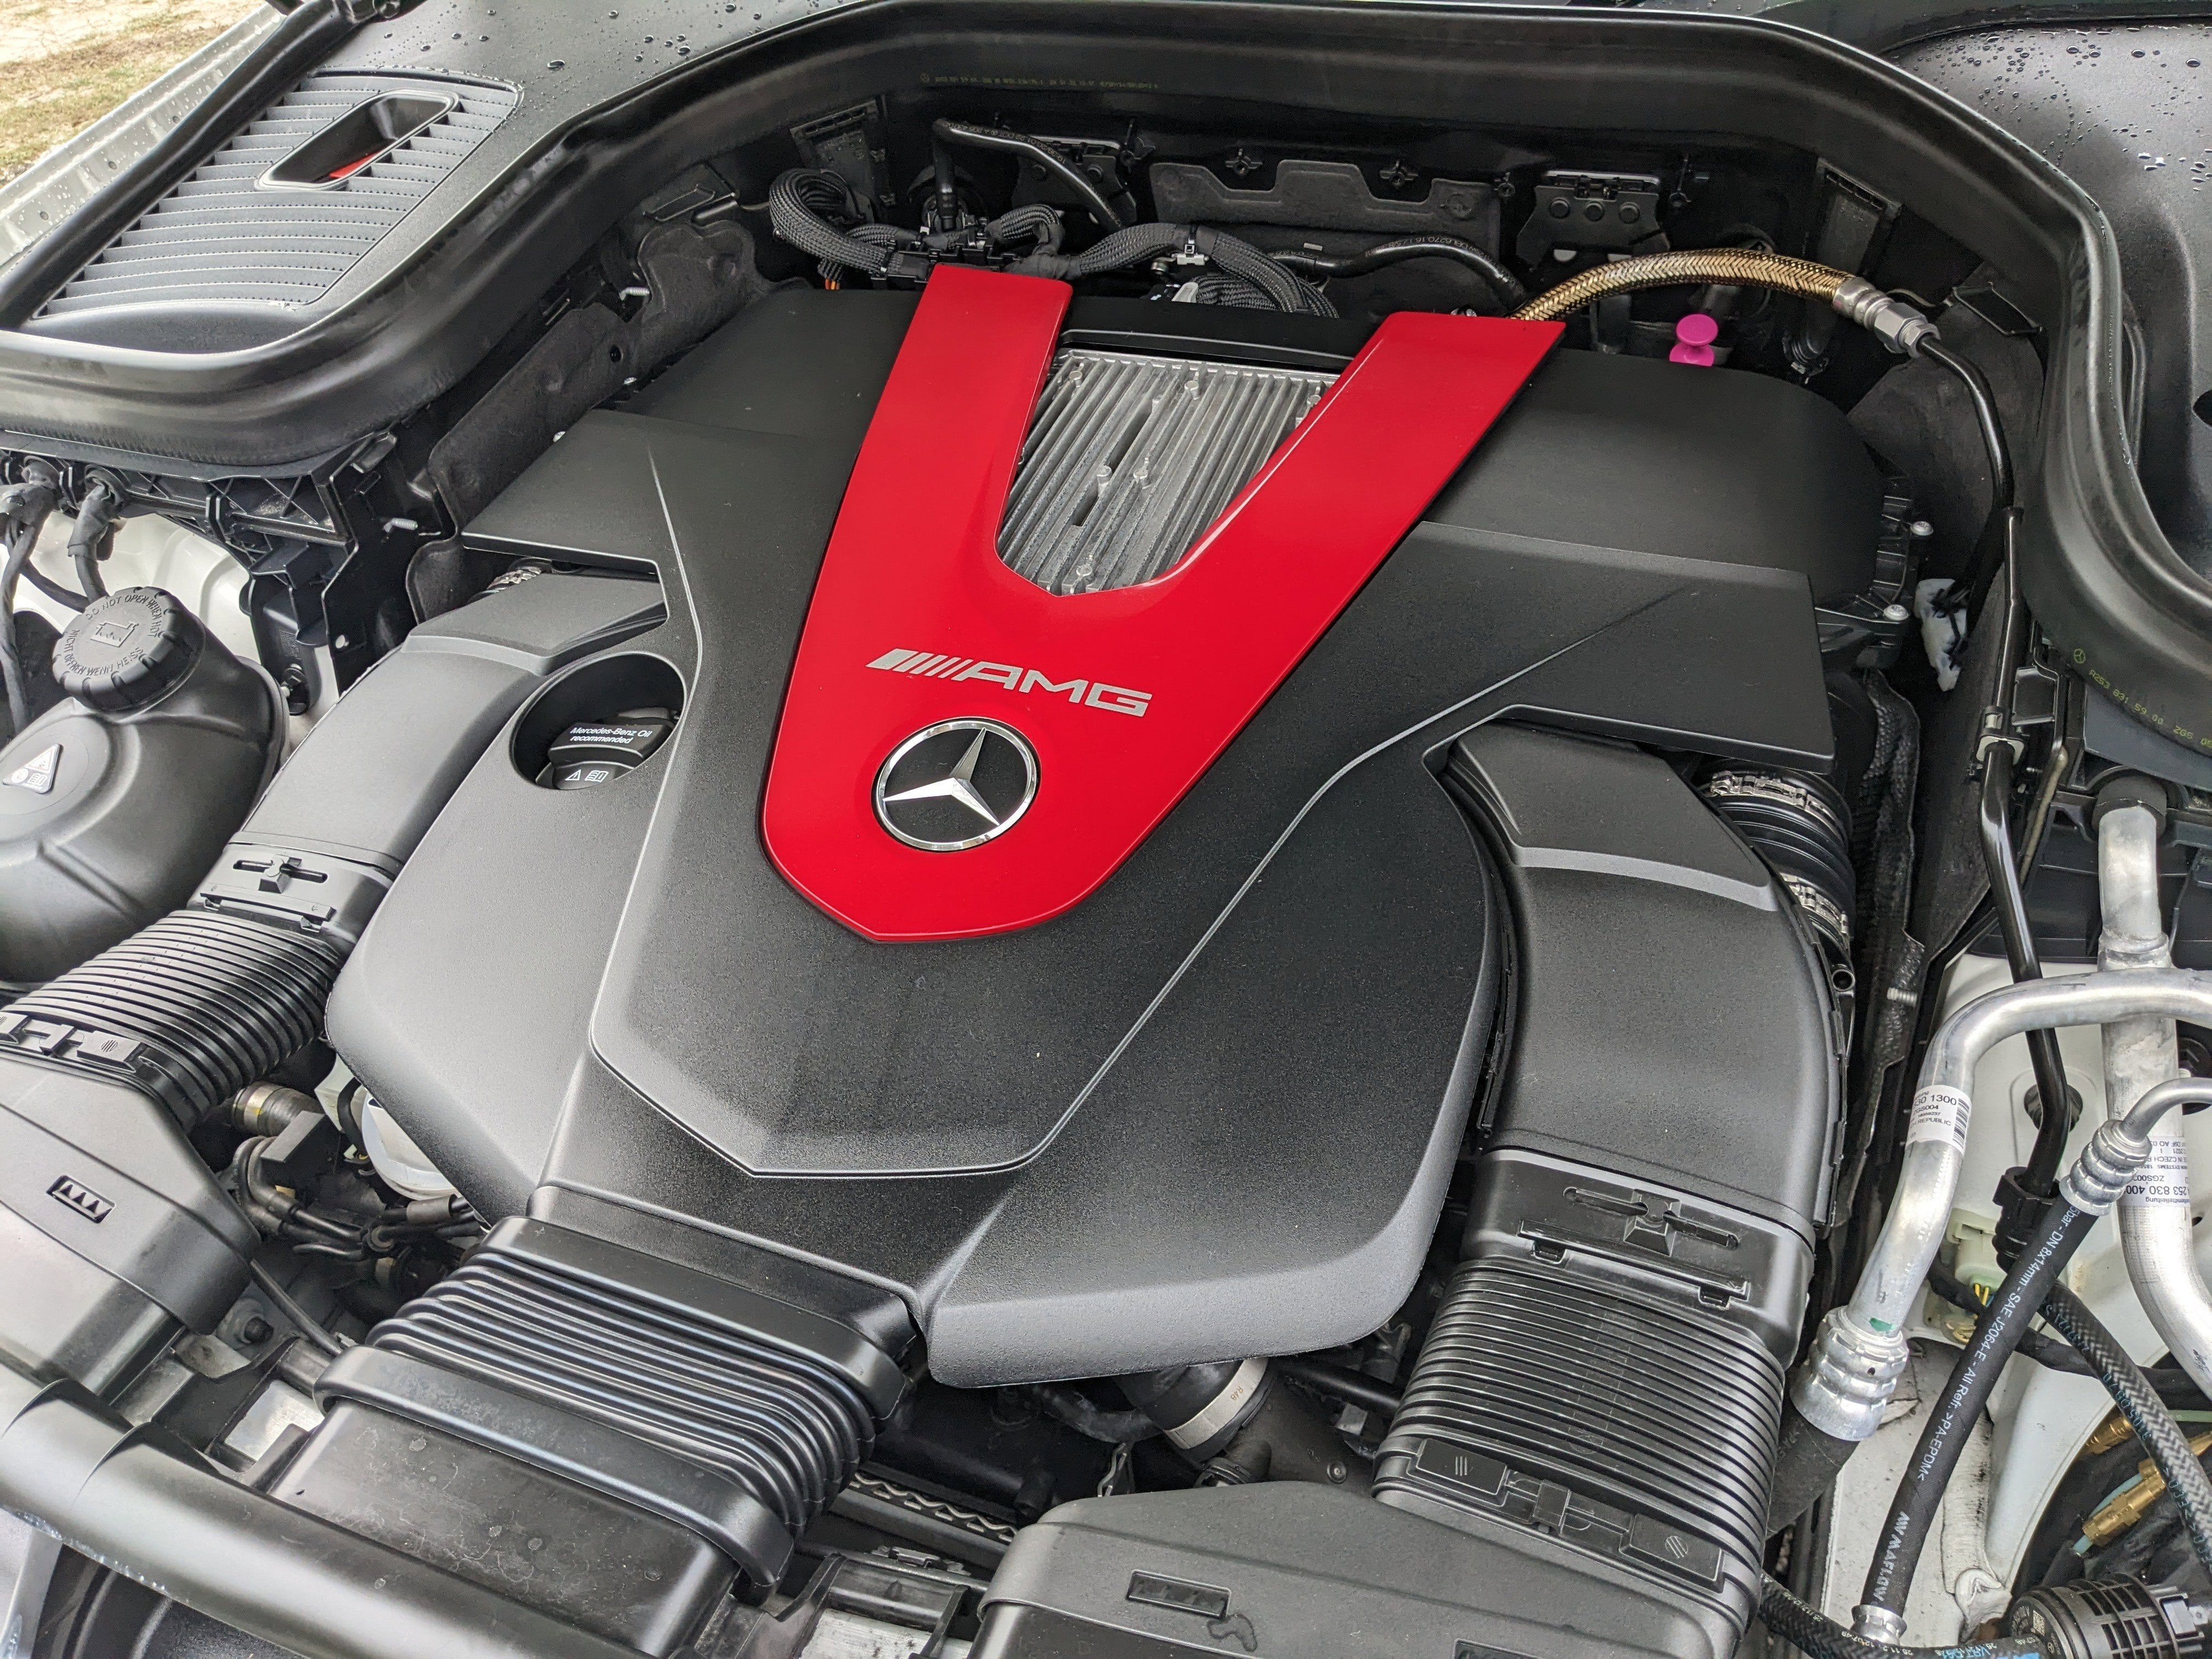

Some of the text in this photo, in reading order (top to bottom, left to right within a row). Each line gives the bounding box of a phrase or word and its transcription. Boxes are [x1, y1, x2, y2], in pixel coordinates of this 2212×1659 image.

[86, 595, 162, 637] DO NOT OPEN WHEN HOT
[64, 630, 80, 652] NICHT
[88, 664, 113, 676] WENN
[116, 647, 144, 669] HEISS
[953, 660, 1153, 717] AMG
[569, 727, 651, 738] Mercedes-Benz Oil
[570, 736, 632, 744] recommended
[1931, 1094, 1957, 1105] 1300
[1917, 1118, 1951, 1126] REPUBLIC
[2124, 1185, 2145, 1194] 400
[2149, 1186, 2169, 1195] 830
[2046, 1231, 2063, 1249] DN
[2018, 1244, 2052, 1289] 8x14mm
[2000, 1291, 2021, 1317] SAE
[1973, 1314, 2006, 1361] J2064-E
[1961, 1367, 1977, 1384] All
[1947, 1383, 1969, 1412] Refr.
[1917, 1414, 1954, 1481] >PA-EPDM<
[1873, 1532, 1902, 1601] MAFLOW
